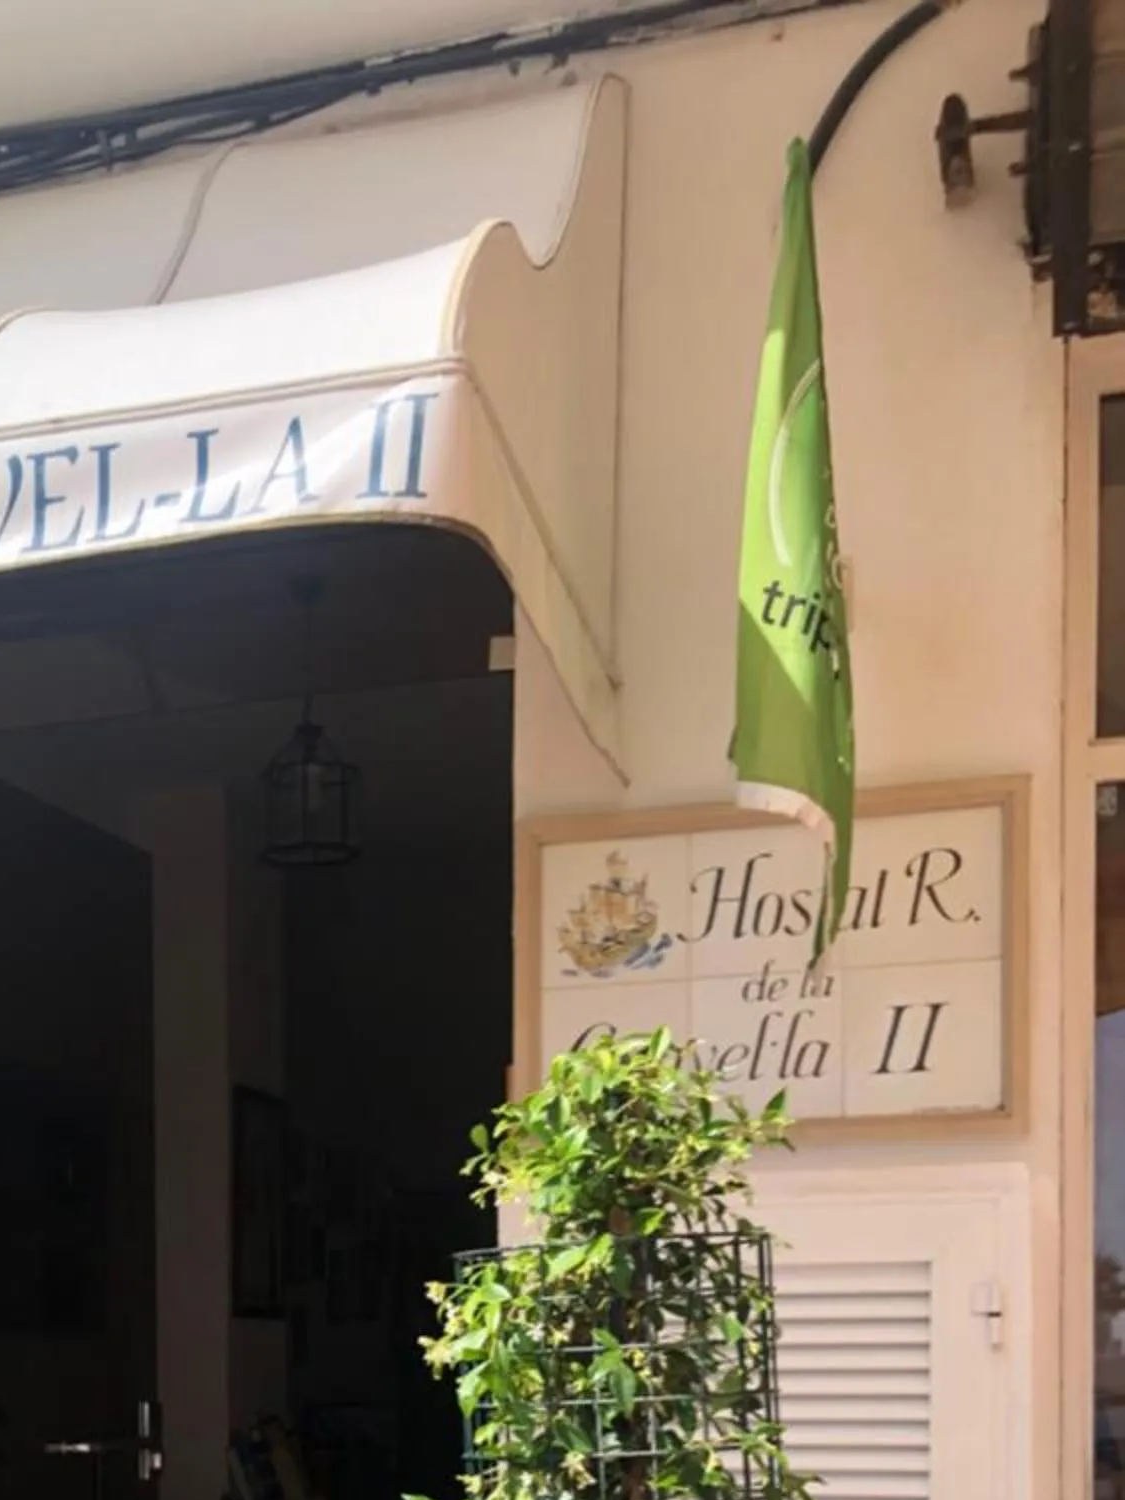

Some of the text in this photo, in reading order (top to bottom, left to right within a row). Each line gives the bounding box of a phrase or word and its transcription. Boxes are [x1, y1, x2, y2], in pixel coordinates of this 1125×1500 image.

[355, 392, 440, 500] II
[675, 846, 982, 943] Hosal R.
[741, 958, 836, 1003] de la
[869, 1001, 950, 1076] II
